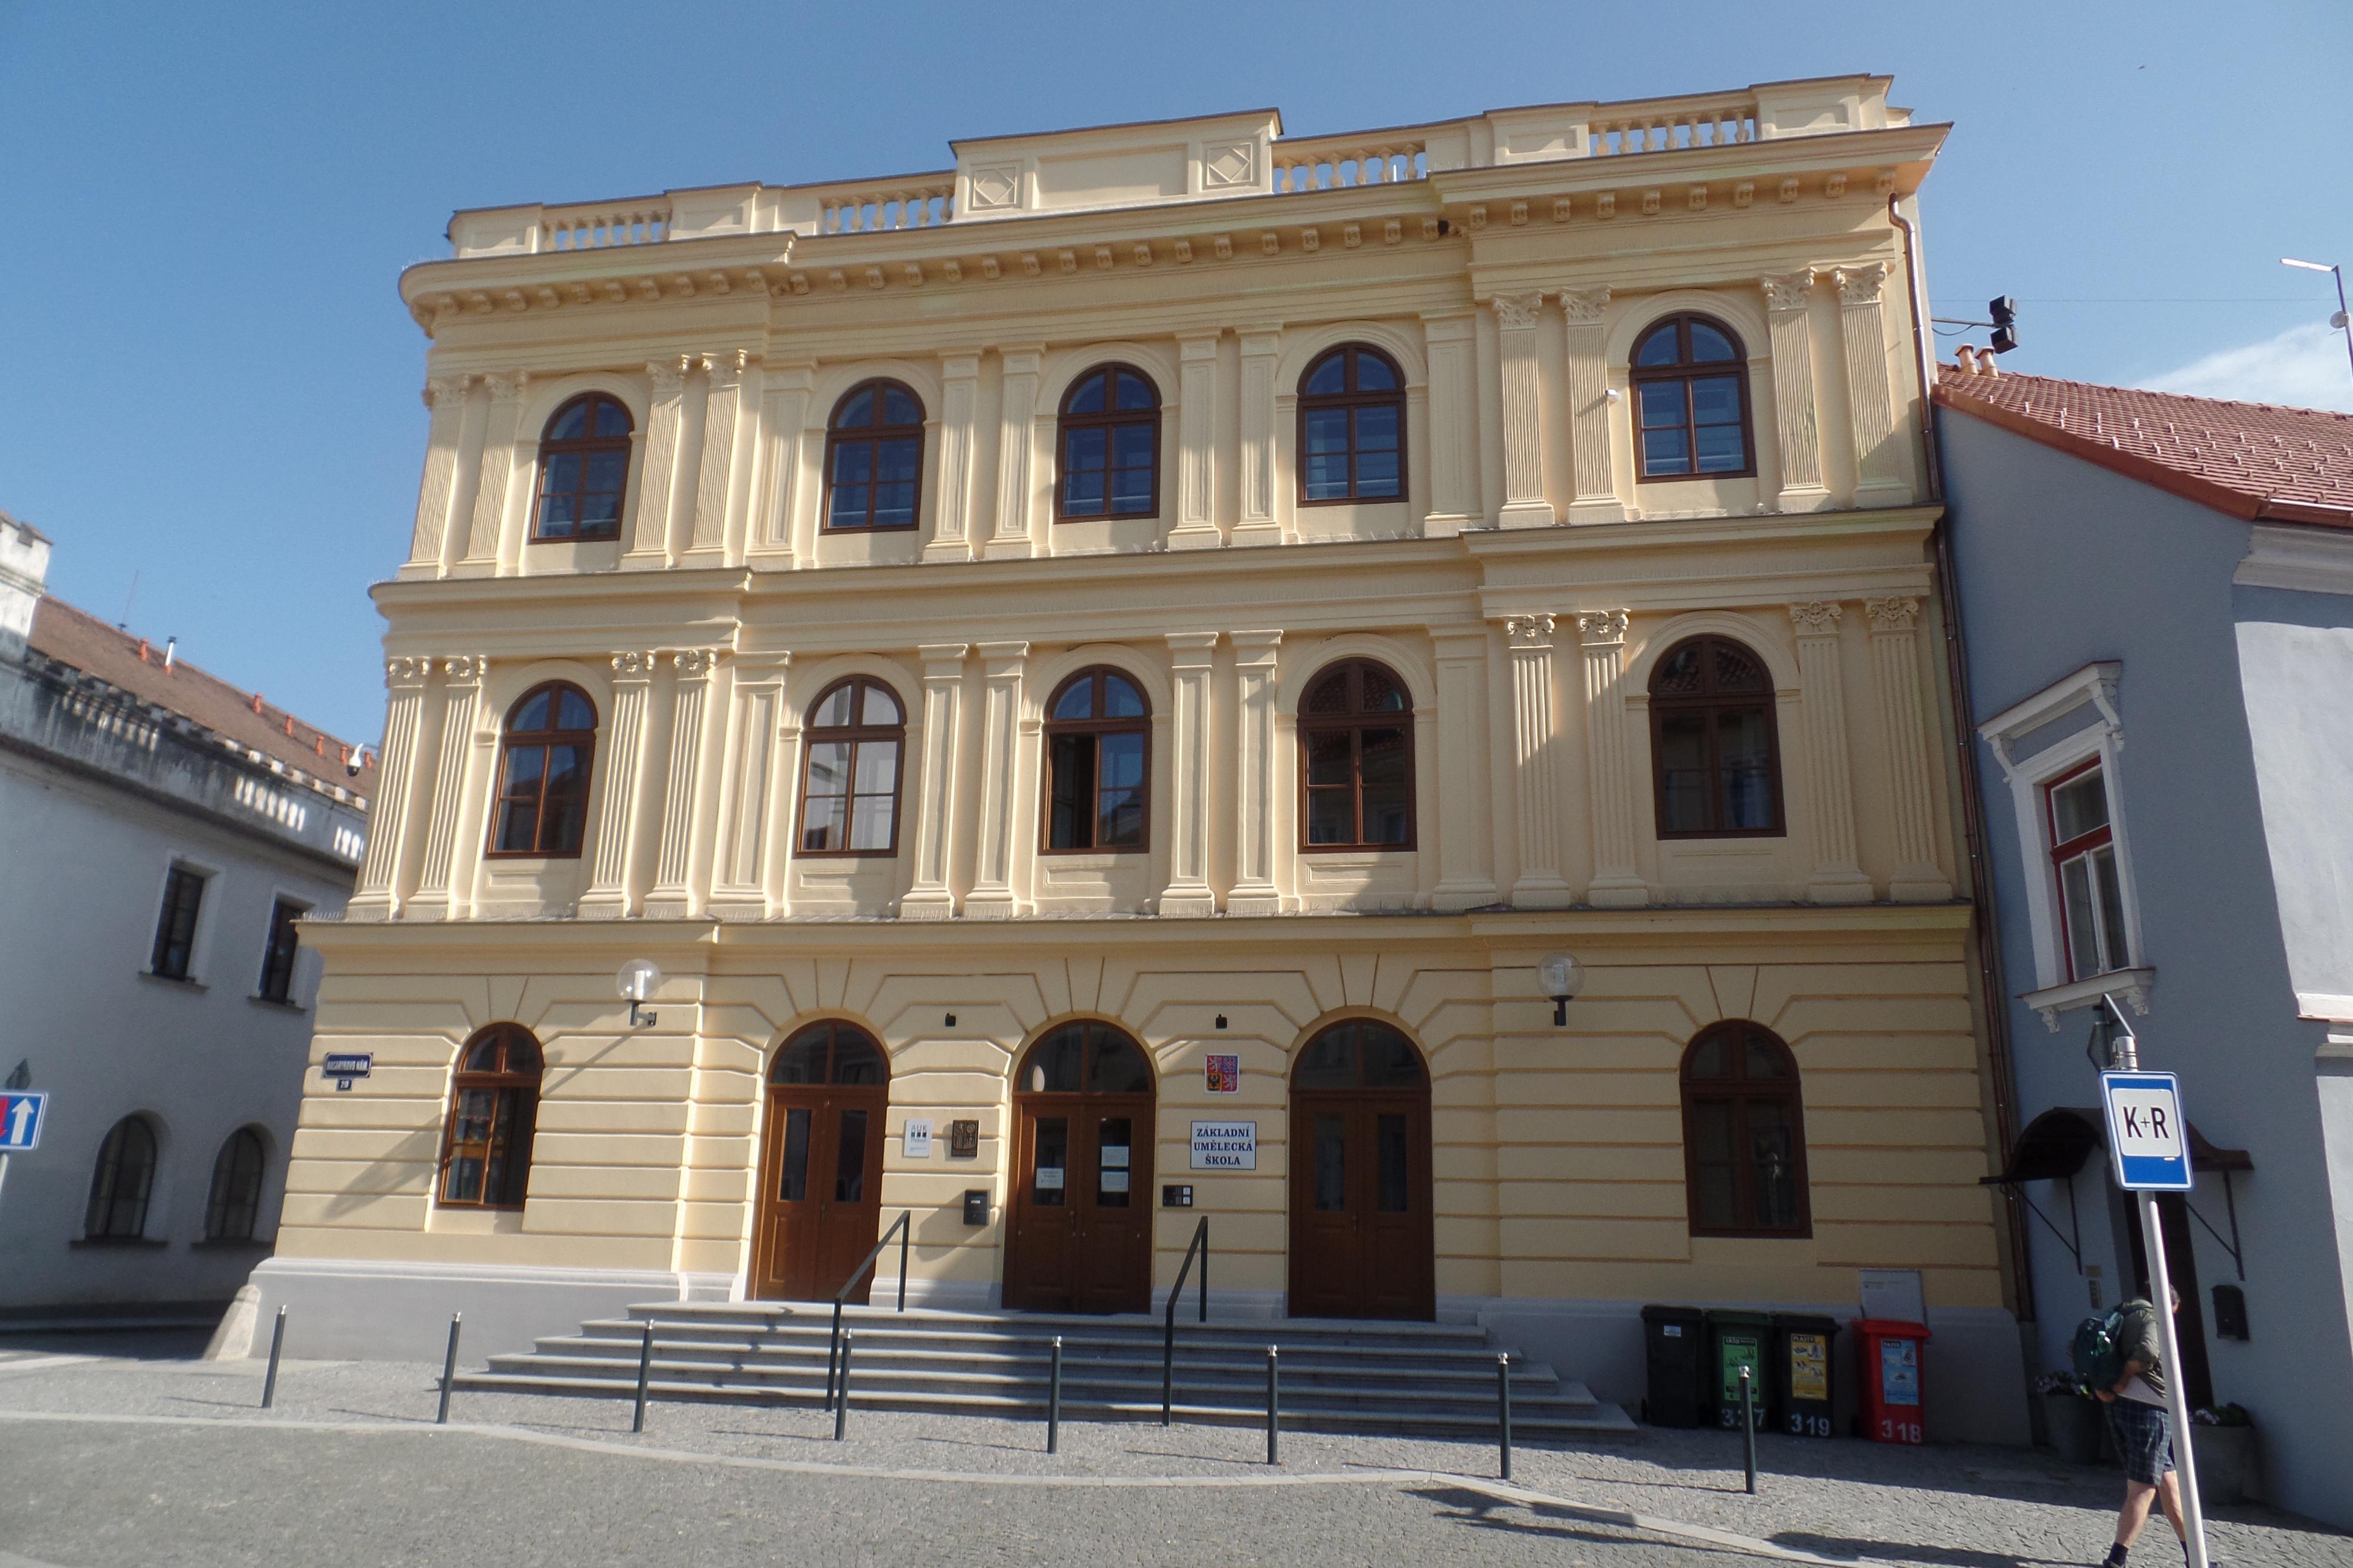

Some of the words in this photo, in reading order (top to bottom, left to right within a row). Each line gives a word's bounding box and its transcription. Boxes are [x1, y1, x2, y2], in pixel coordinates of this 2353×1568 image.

[1197, 1125, 1250, 1137] ZÁKLADNÍ
[2122, 1106, 2169, 1139] K+R
[1194, 1140, 1253, 1151] UMĚLECKÁ
[1205, 1153, 1241, 1165] ŠKOLA
[1791, 1413, 1830, 1436] 319
[1882, 1420, 1921, 1443] 318
